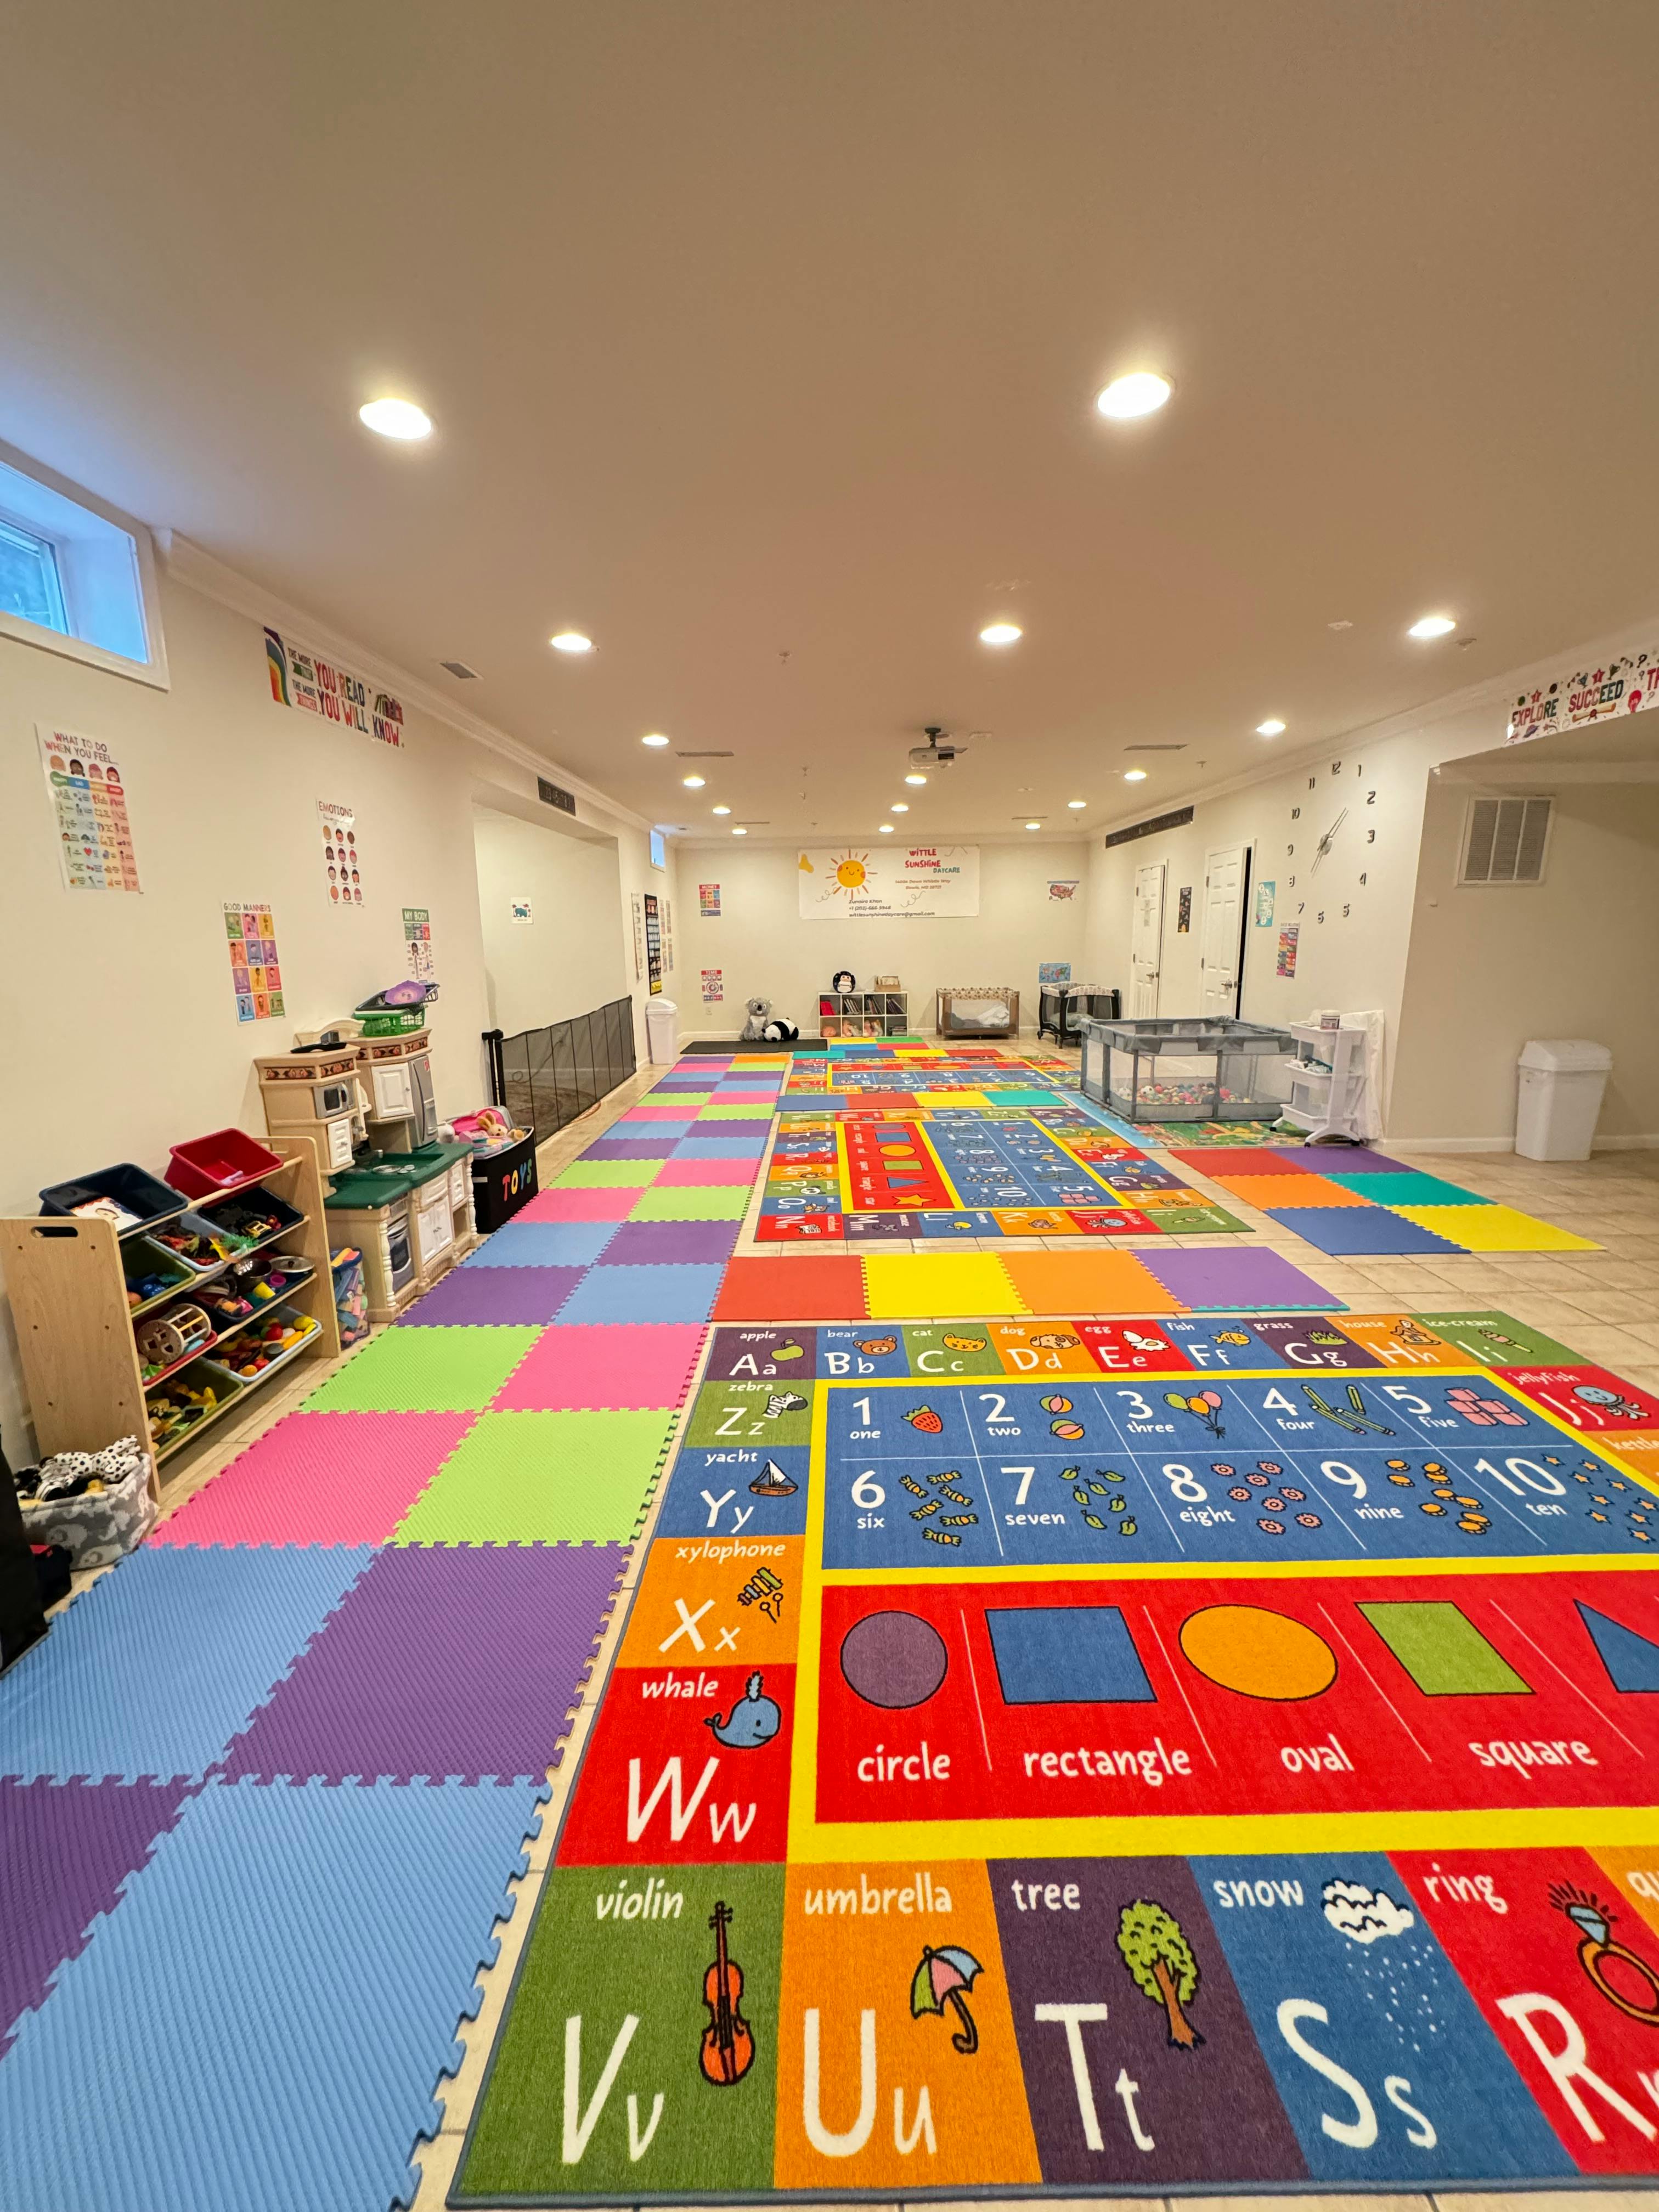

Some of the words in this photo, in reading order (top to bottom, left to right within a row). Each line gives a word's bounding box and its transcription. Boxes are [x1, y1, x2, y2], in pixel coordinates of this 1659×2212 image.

[314, 659, 336, 693] YOU
[338, 673, 365, 707] READ
[1512, 698, 1559, 728] EXPLORE
[1568, 680, 1624, 713] SUCCEED
[317, 689, 340, 721] YOU
[342, 701, 369, 734] WILL
[372, 714, 399, 747] KNOW
[44, 740, 71, 755] WHEN
[74, 747, 91, 759] YOU
[54, 731, 79, 746] WHAT
[81, 738, 93, 749] TO
[95, 742, 108, 753] DO
[1358, 764, 1362, 777] 1
[1309, 777, 1316, 790] 11
[1367, 791, 1376, 805] 2
[318, 801, 353, 817] EMOTIONS
[1291, 808, 1300, 820] 10
[1367, 830, 1375, 844] 3
[1288, 844, 1294, 856] 9
[1289, 875, 1295, 887] 8
[224, 902, 241, 911] GOOD
[243, 904, 272, 912] MANNERS
[404, 911, 413, 920] MY
[414, 911, 427, 921] BODY
[1297, 902, 1305, 914] 7
[503, 1158, 532, 1201] TOYS
[994, 1186, 1028, 1198] 10
[1001, 1326, 1025, 1336] dog
[1167, 1322, 1194, 1330] fish
[1339, 1320, 1386, 1329] house
[740, 1331, 776, 1341] apple
[729, 1381, 772, 1391] zebra
[1508, 1372, 1580, 1385] jellyfish
[979, 1394, 1014, 1422] 2
[1117, 1391, 1153, 1419] 3
[1263, 1388, 1298, 1415] 4
[1381, 1386, 1432, 1414] 5
[854, 1397, 870, 1425] 1
[1127, 1421, 1175, 1432] three
[1277, 1419, 1314, 1430] four
[1418, 1416, 1459, 1427] five
[850, 1431, 881, 1439] one
[988, 1427, 1020, 1436] two
[705, 1449, 758, 1466] yacht
[1001, 1467, 1035, 1505] 7
[1163, 1464, 1207, 1502] 8
[1320, 1462, 1367, 1499] 9
[1474, 1458, 1566, 1497] 10
[851, 1470, 885, 1508] 6
[1180, 1506, 1235, 1526] eight
[1355, 1504, 1403, 1519] nine
[1526, 1504, 1567, 1515] ten
[857, 1513, 884, 1528] six
[1005, 1514, 1065, 1525] seven
[675, 1539, 786, 1564] xylophone
[642, 1672, 718, 1698] whale
[857, 1741, 950, 1781] circle
[1024, 1737, 1192, 1786] rectangle
[1281, 1734, 1353, 1772] oval
[1469, 1741, 1598, 1779] square
[805, 1872, 952, 1914] umbrella
[1012, 1880, 1080, 1911] tree
[1214, 1881, 1304, 1908] snow
[1423, 1863, 1508, 1914] ring
[597, 1877, 683, 1920] violin
